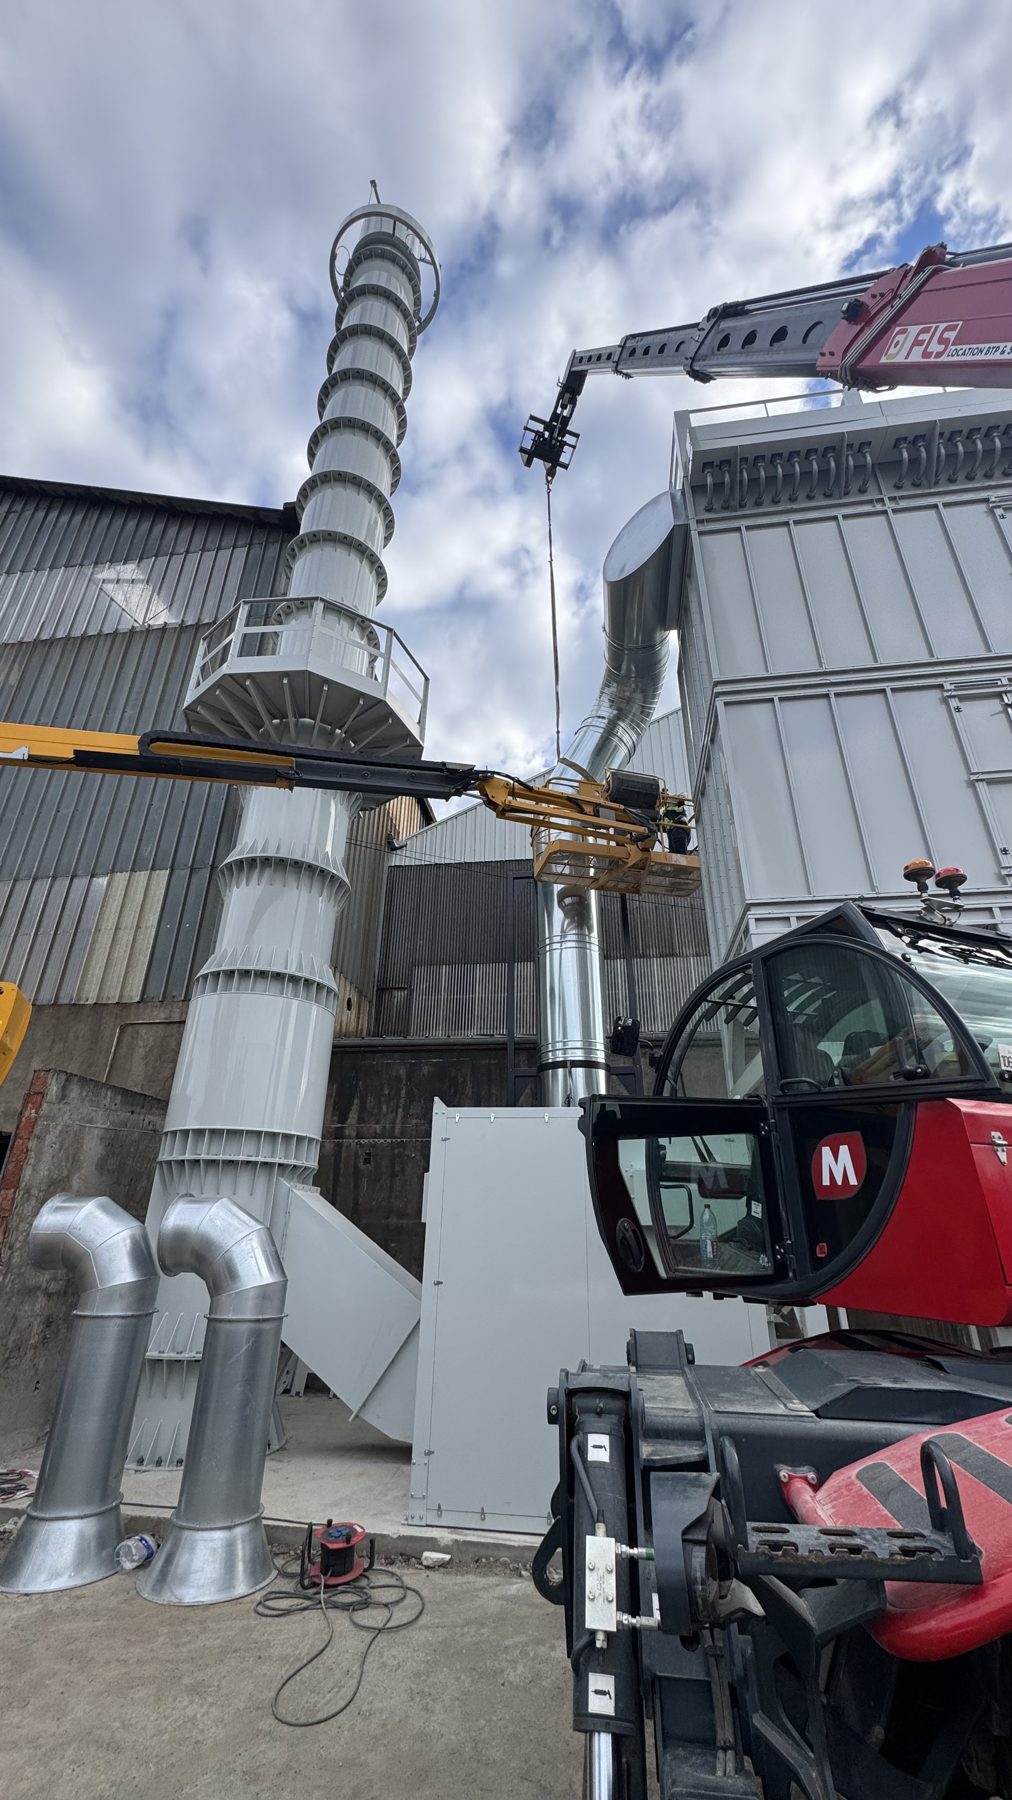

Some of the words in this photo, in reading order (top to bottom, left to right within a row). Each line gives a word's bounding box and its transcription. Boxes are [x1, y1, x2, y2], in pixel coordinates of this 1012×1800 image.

[904, 324, 960, 360] FLS
[946, 347, 985, 358] LOCATION
[984, 345, 1001, 356] BTP
[821, 1144, 858, 1186] M
